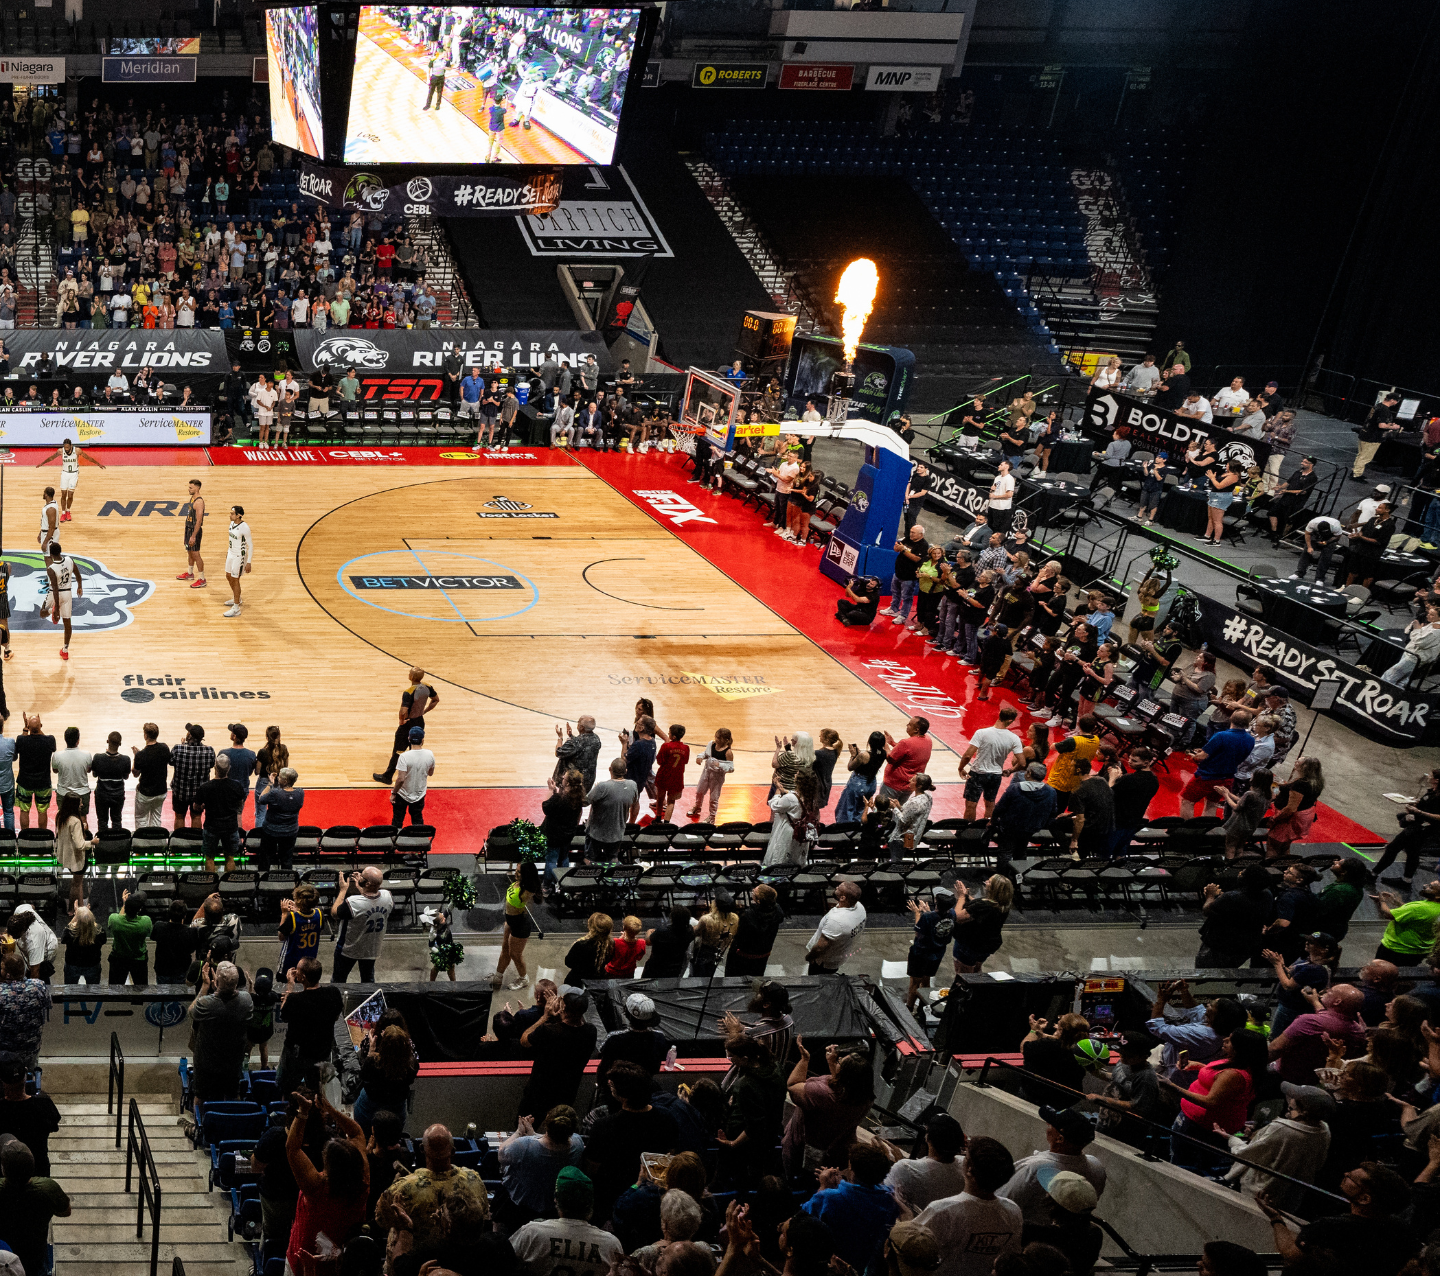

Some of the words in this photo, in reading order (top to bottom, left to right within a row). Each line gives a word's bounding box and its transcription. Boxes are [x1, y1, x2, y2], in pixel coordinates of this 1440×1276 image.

[551, 28, 584, 54] LIONS
[11, 62, 54, 75] Niagara
[121, 61, 180, 74] Meridian
[717, 70, 763, 80] ROBERTS
[798, 70, 836, 78] BARBECUE
[875, 71, 912, 86] MNP
[404, 204, 432, 214] CEBL
[537, 239, 659, 250] LIVING
[743, 315, 759, 331] 00.0
[54, 341, 176, 351] NIAGARA
[442, 341, 561, 352] NIAGARA
[121, 351, 213, 367] LIONS
[736, 426, 766, 435] arket
[1127, 407, 1210, 445] BOLDT
[242, 450, 288, 461] WATCH
[287, 450, 319, 461] LIVE
[362, 577, 515, 587] BETVICTOR
[122, 674, 186, 686] flair
[159, 687, 271, 700] airlines
[714, 685, 772, 694] Restore
[366, 918, 384, 932] 23
[298, 932, 318, 949] 30
[549, 1237, 602, 1264] ELIA
